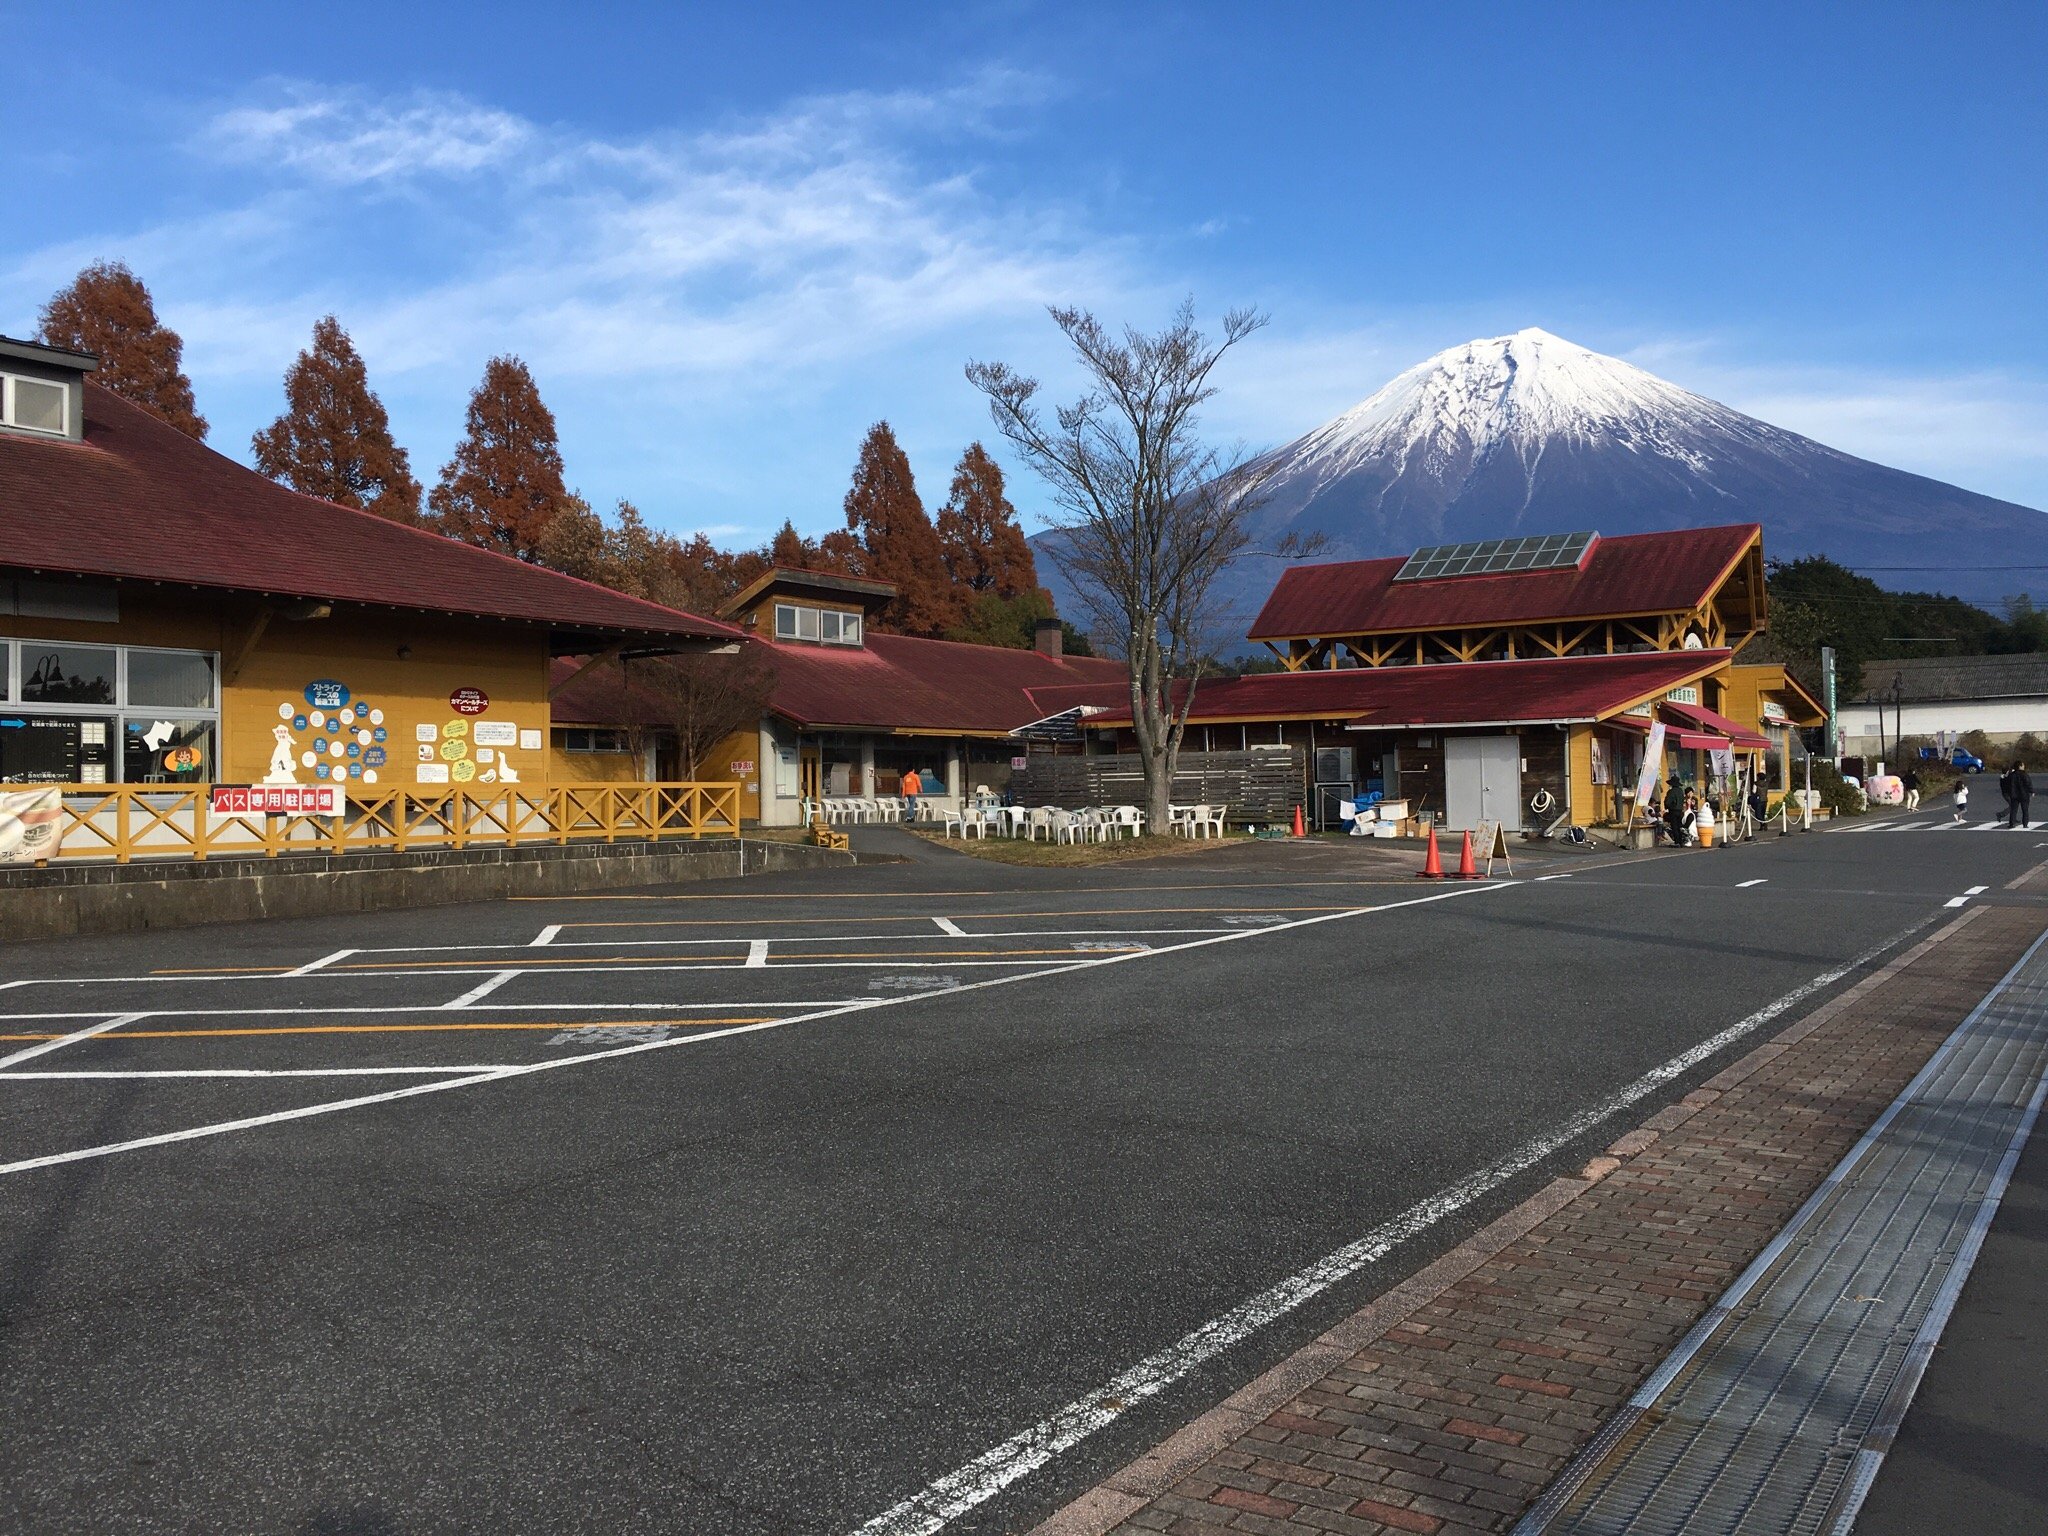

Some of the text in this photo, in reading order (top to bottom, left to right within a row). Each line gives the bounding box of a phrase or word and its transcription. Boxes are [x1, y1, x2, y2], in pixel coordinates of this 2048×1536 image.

[316, 691, 339, 699] チーズの
[450, 698, 489, 706] カマンベールチーズ
[732, 762, 752, 770] お手洗い
[215, 793, 332, 808] バス専用駐車場
